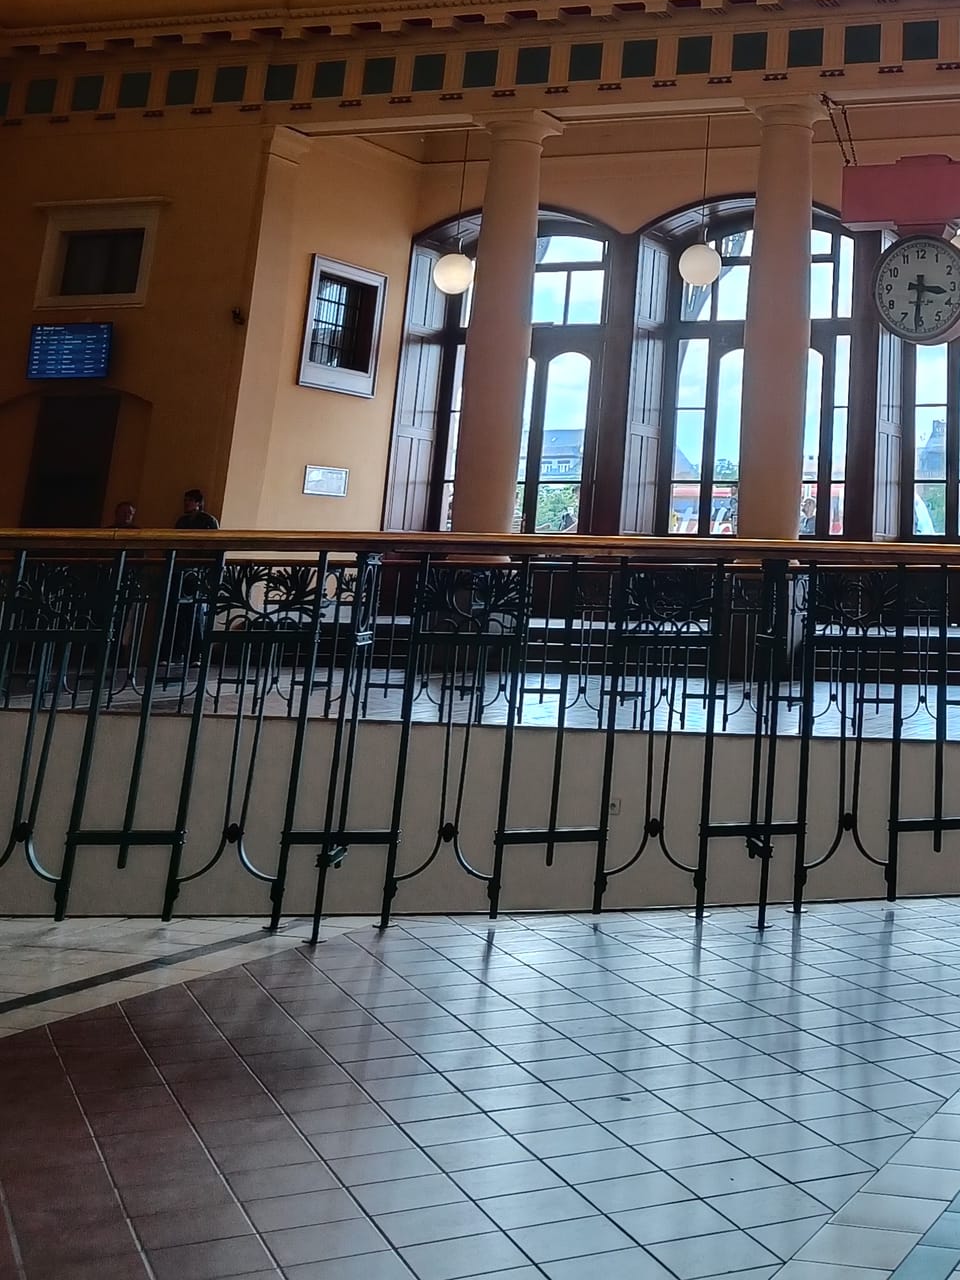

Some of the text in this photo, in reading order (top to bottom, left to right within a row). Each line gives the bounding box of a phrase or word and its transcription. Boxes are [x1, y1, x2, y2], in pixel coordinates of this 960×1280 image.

[902, 254, 909, 264] 11
[916, 249, 927, 259] 12
[935, 253, 939, 263] 1
[889, 267, 899, 278] 10
[946, 265, 952, 275] 2
[885, 284, 893, 294] 9
[949, 281, 956, 291] 3
[888, 299, 894, 310] 8
[944, 297, 952, 307] 4
[901, 312, 908, 322] 7
[918, 316, 924, 326] 6
[935, 311, 942, 321] 5
